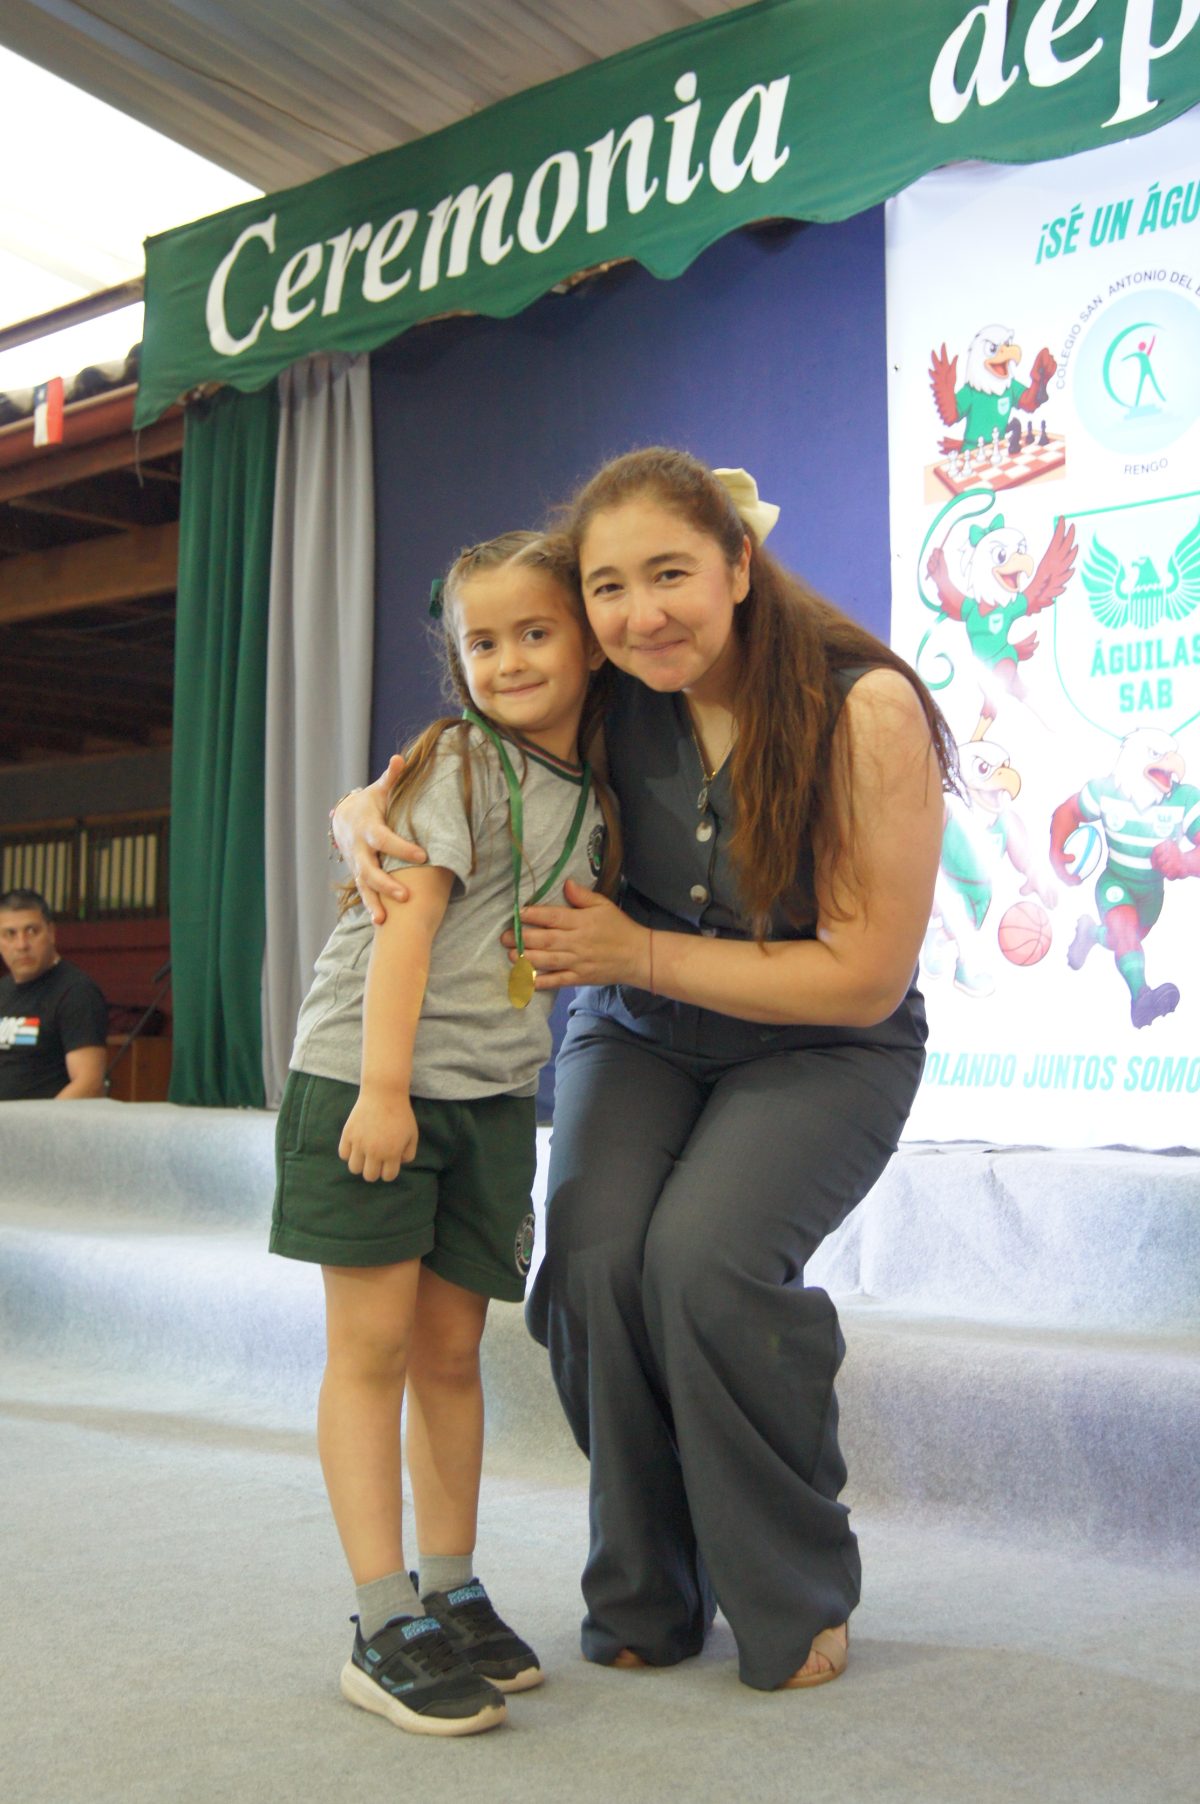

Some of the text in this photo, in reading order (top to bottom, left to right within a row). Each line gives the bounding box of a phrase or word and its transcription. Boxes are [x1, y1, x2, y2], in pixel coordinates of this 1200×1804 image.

[206, 72, 790, 356] Ceremonia
[1035, 180, 1200, 265] ¡SÉ UN ÁGU
[1056, 324, 1081, 390] COLEGIO
[1080, 295, 1103, 323] SAN
[1108, 269, 1167, 297] ANTONIO
[1169, 271, 1193, 291] DEL
[1123, 457, 1168, 476] RENGO
[1118, 677, 1174, 713] SAB
[1023, 1053, 1119, 1092] JUNTOS
